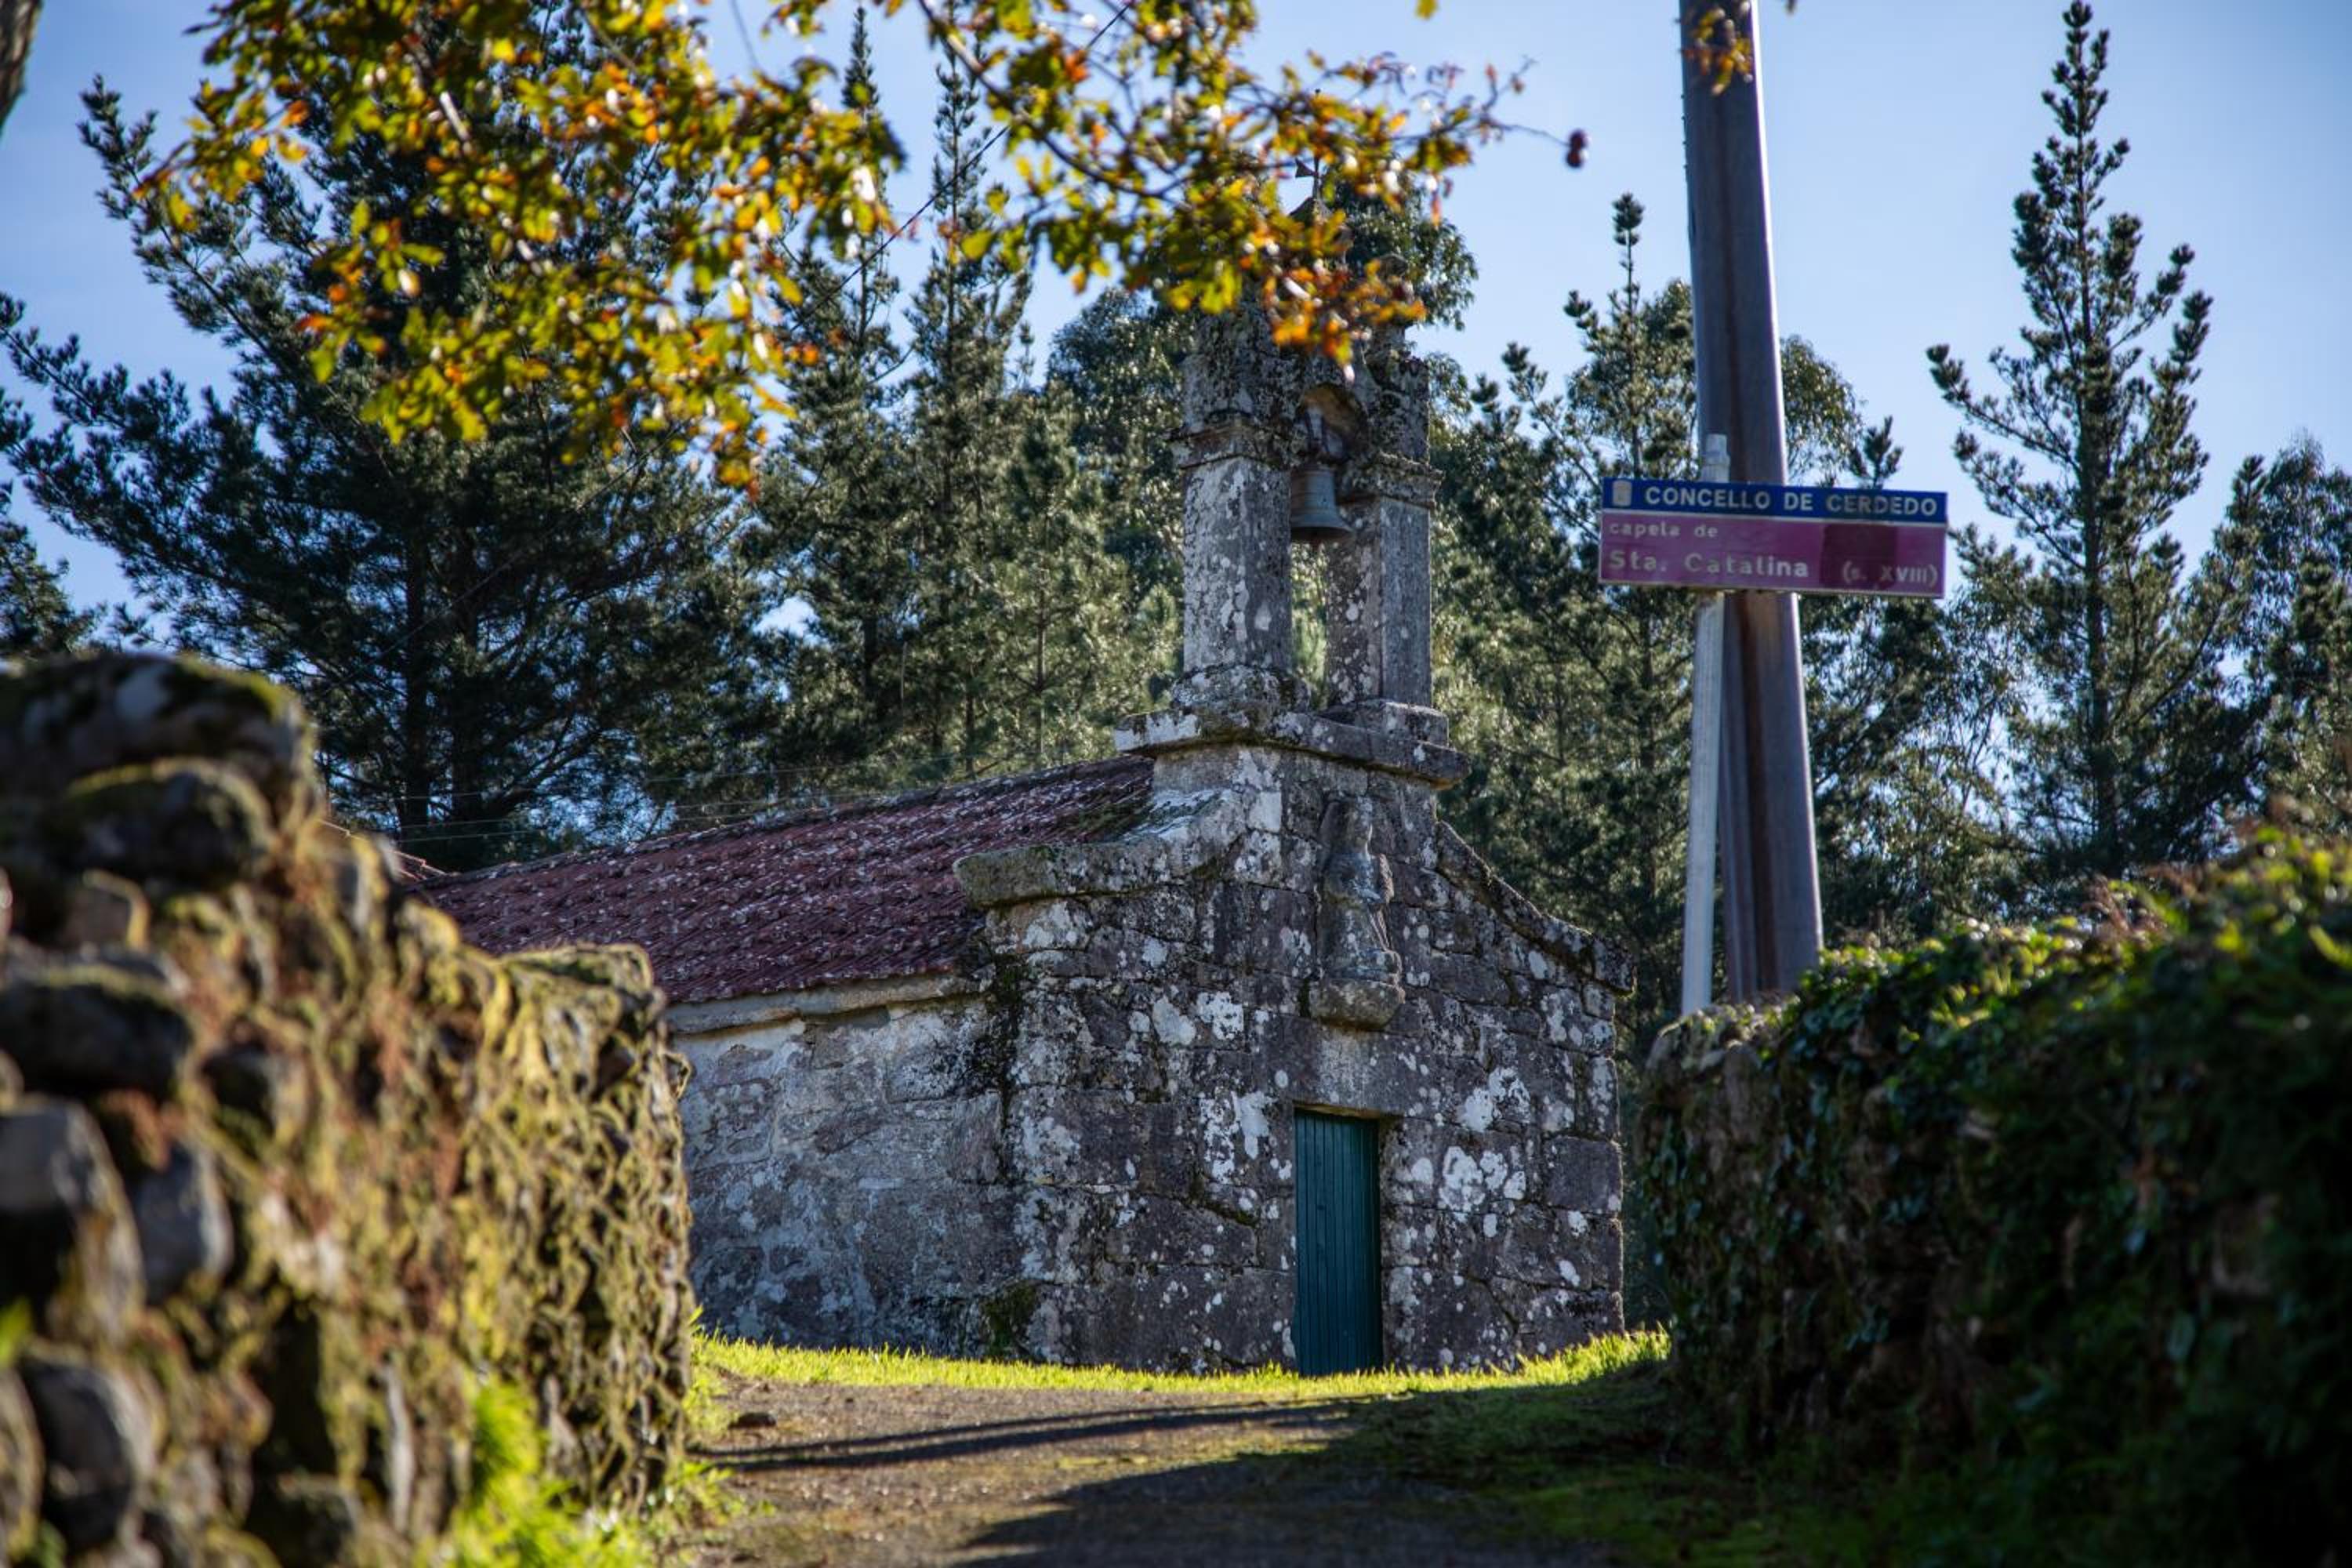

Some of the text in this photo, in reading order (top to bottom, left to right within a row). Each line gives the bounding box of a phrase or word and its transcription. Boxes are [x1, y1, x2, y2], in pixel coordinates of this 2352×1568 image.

[1644, 486, 1937, 517] CONCELLO DE CERDEDO
[1610, 521, 1719, 539] capela de
[1609, 552, 1667, 572] Sta.
[1684, 554, 1809, 578] Catalina
